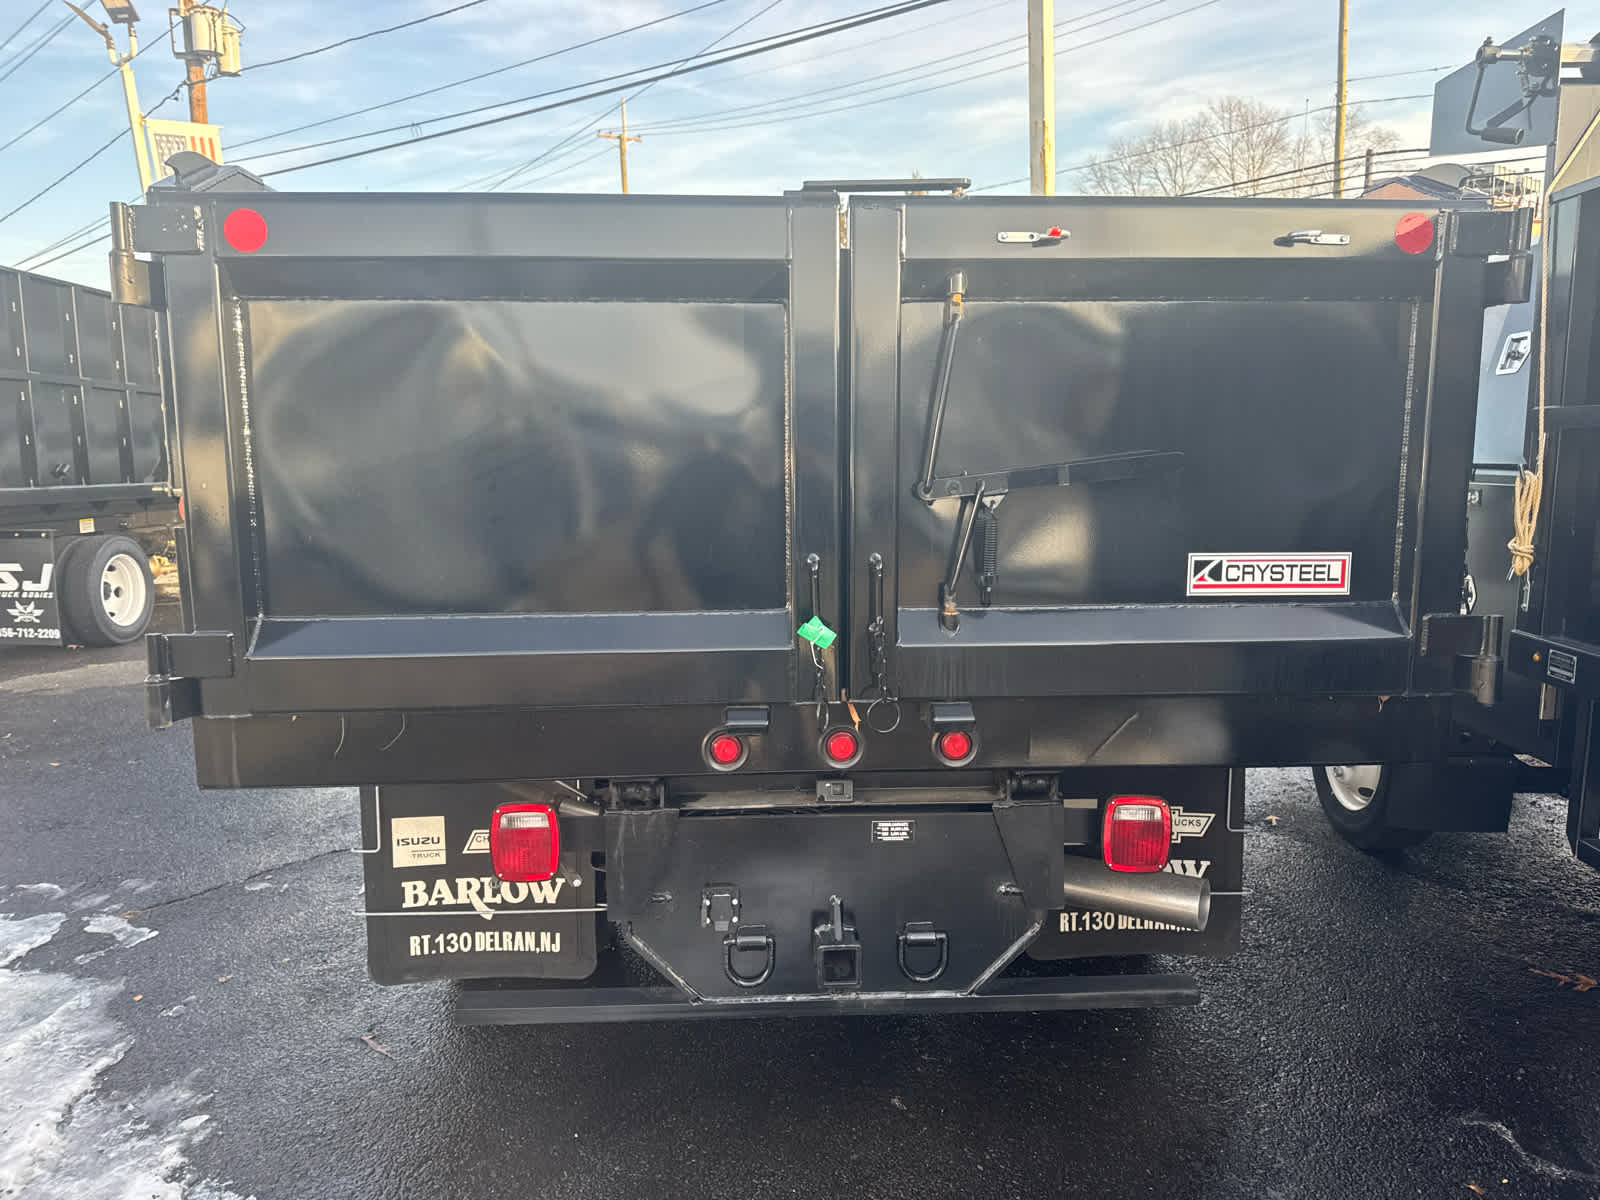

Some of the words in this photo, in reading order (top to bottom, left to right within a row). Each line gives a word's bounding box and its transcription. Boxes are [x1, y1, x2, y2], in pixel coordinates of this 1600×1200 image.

[1225, 564, 1339, 582] CRYSTEEL
[1174, 818, 1202, 827] UCKS
[396, 836, 441, 847] ISUZU
[401, 876, 565, 921] BARLOW
[1060, 912, 1115, 933] RT.130
[409, 932, 473, 956] RT.130
[475, 931, 561, 954] DELRAN,NJ
